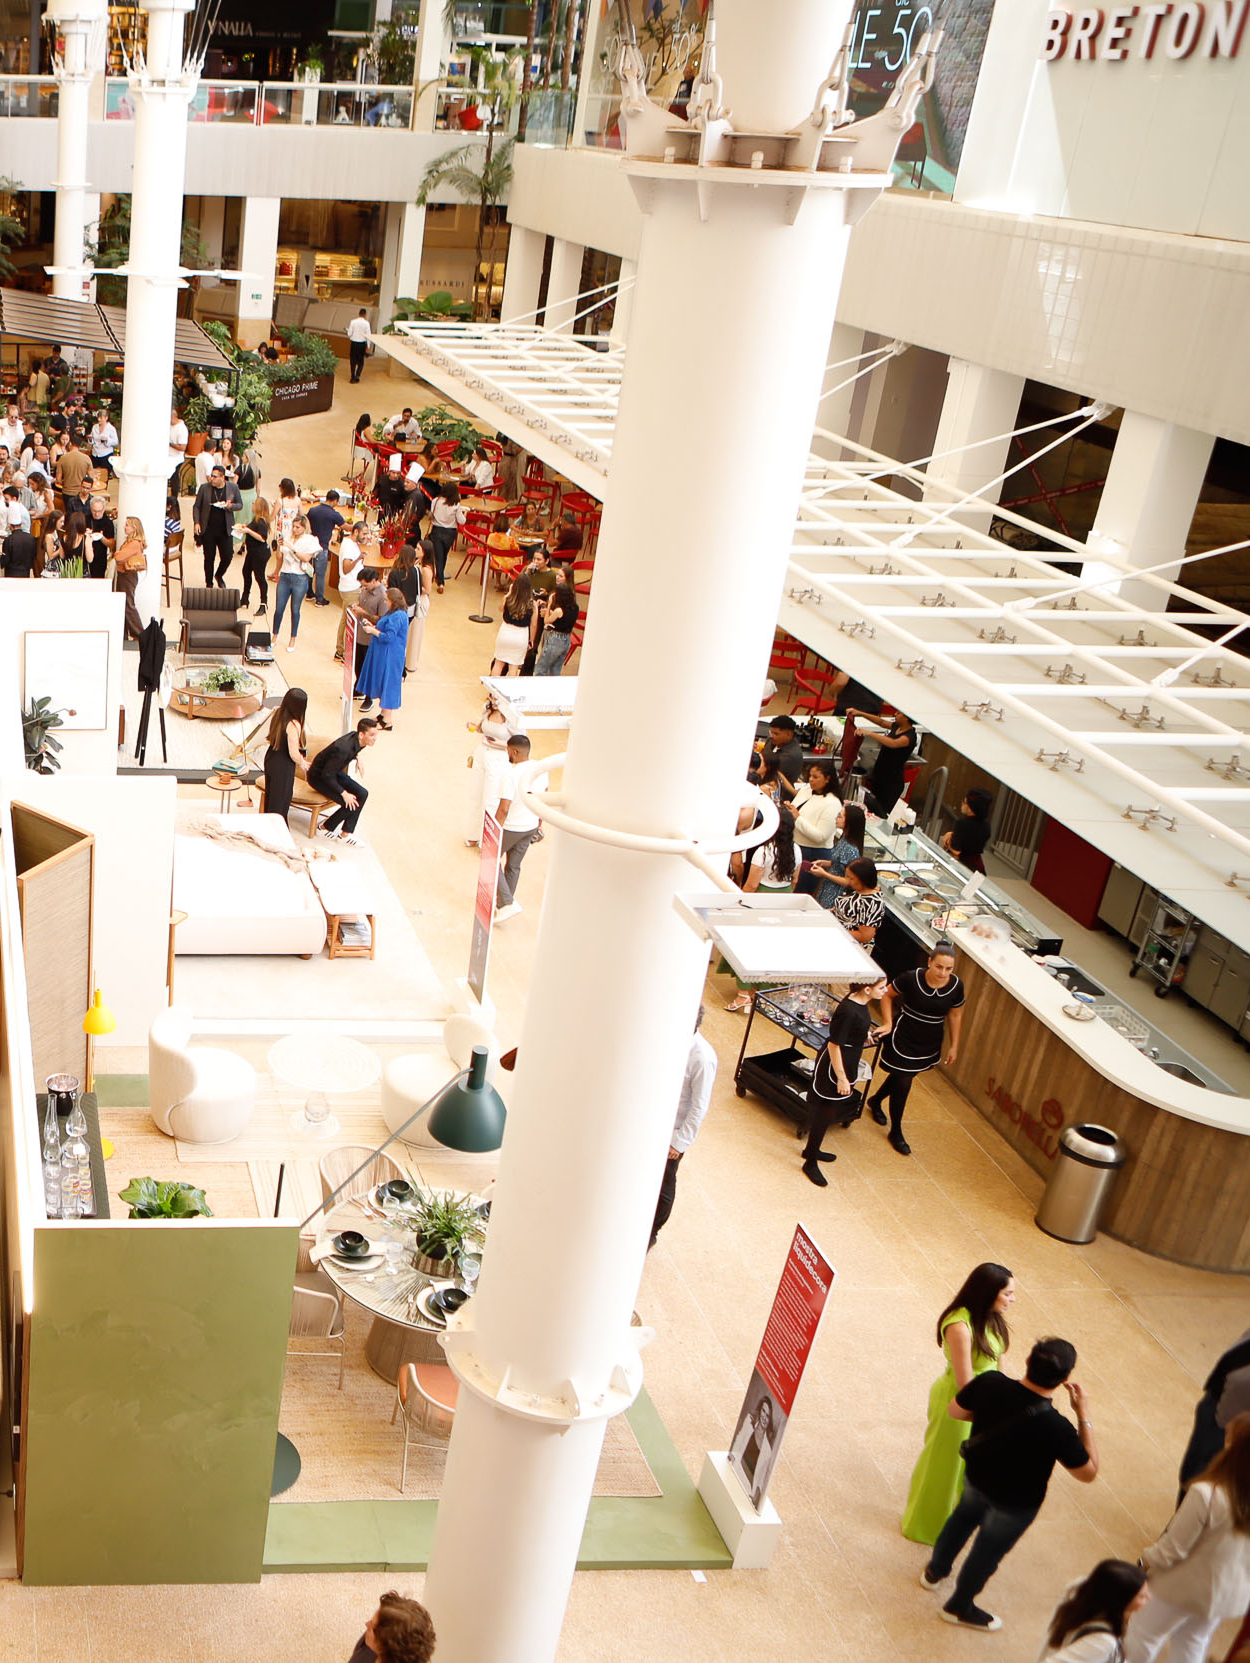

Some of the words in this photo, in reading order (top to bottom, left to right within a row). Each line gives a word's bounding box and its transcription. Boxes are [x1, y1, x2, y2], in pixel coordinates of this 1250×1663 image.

[1038, 0, 1249, 61] BRETON
[275, 384, 301, 397] CHICAGO
[792, 1240, 827, 1295] liquidecora
[796, 1231, 818, 1266] mostra
